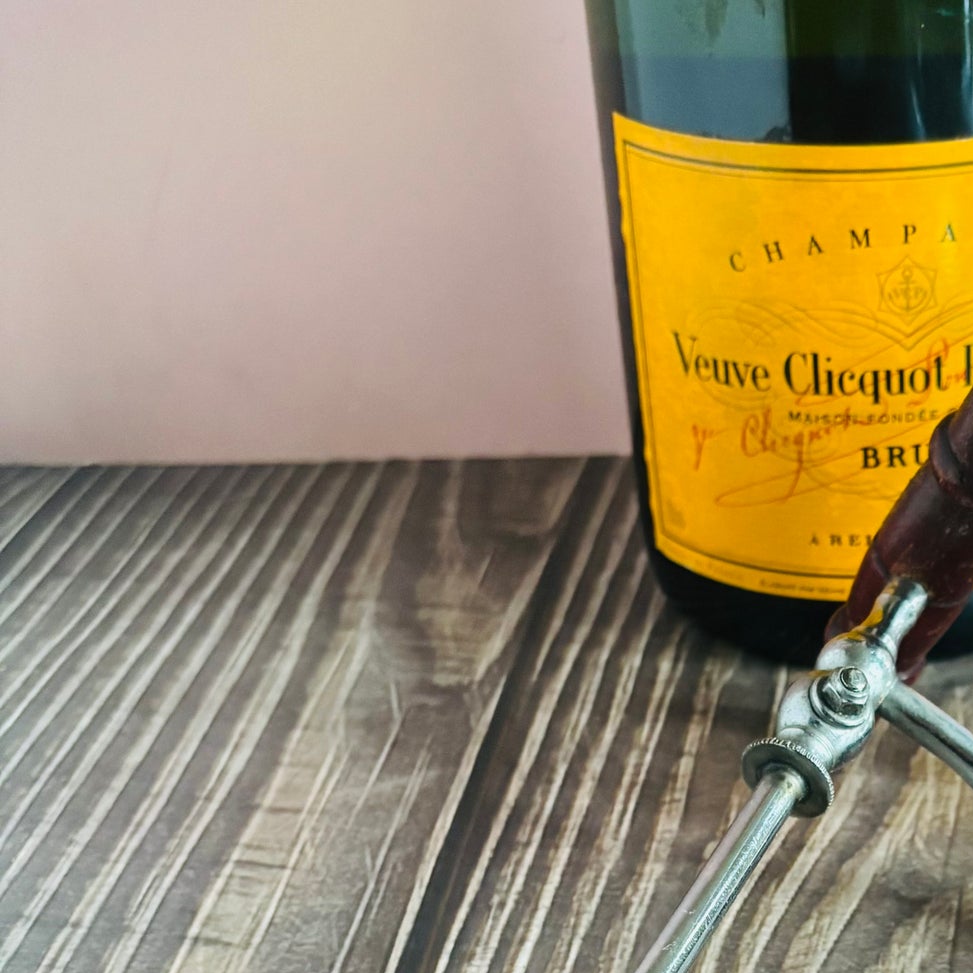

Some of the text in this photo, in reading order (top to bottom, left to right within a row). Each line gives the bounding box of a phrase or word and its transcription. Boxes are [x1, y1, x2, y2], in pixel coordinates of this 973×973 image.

[672, 330, 772, 392] Veuve
[783, 351, 949, 404] Clicquot
[860, 443, 930, 470] BRU
[828, 533, 873, 547] REI
